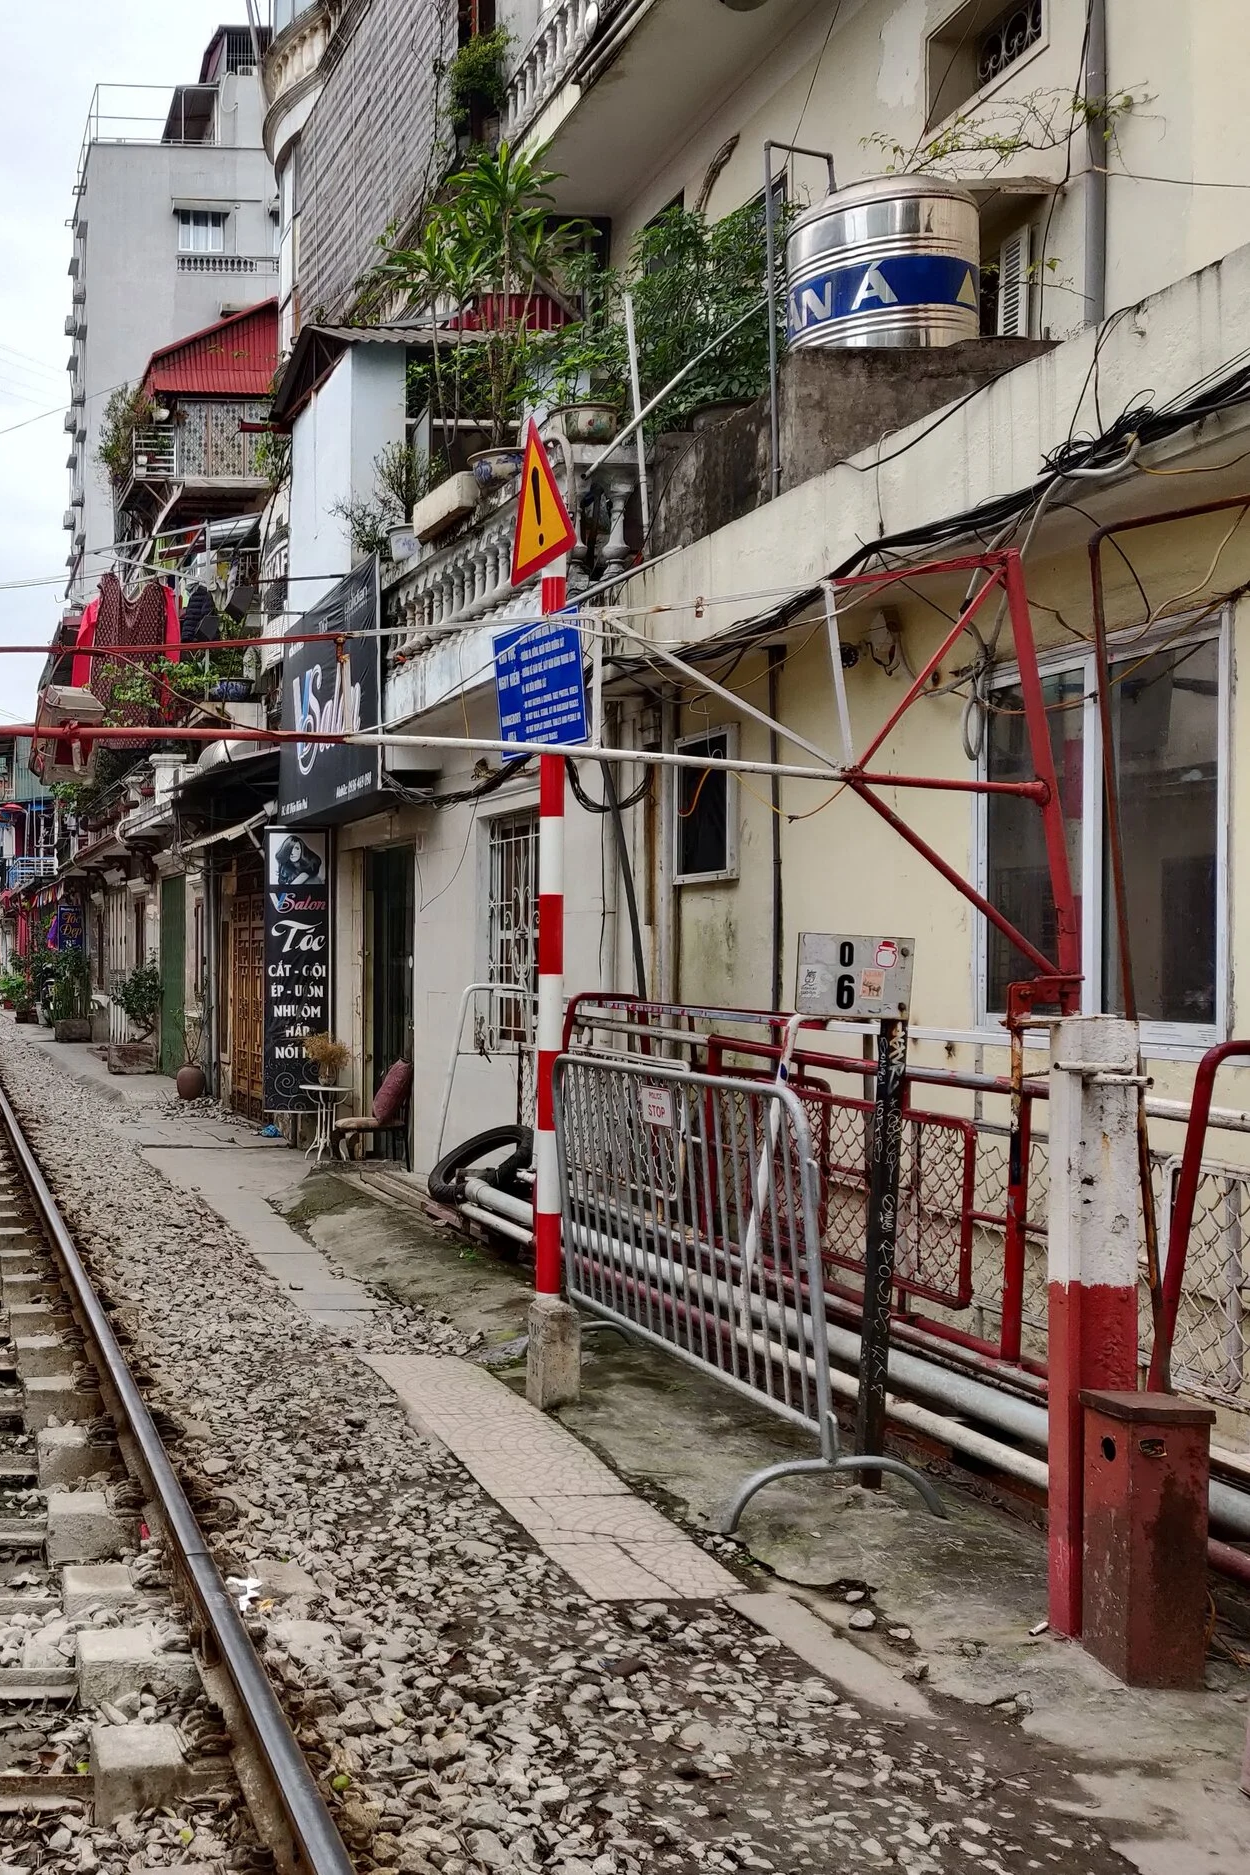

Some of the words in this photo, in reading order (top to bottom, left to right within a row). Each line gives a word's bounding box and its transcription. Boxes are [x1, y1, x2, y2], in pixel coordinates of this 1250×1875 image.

[271, 920, 326, 952] Tóc
[268, 960, 291, 977] CẮT
[271, 982, 284, 997] ÉP
[836, 974, 855, 1010] 6
[275, 1043, 298, 1059] NỐI
[648, 1091, 662, 1100] POLICE
[648, 1104, 666, 1118] STOP
